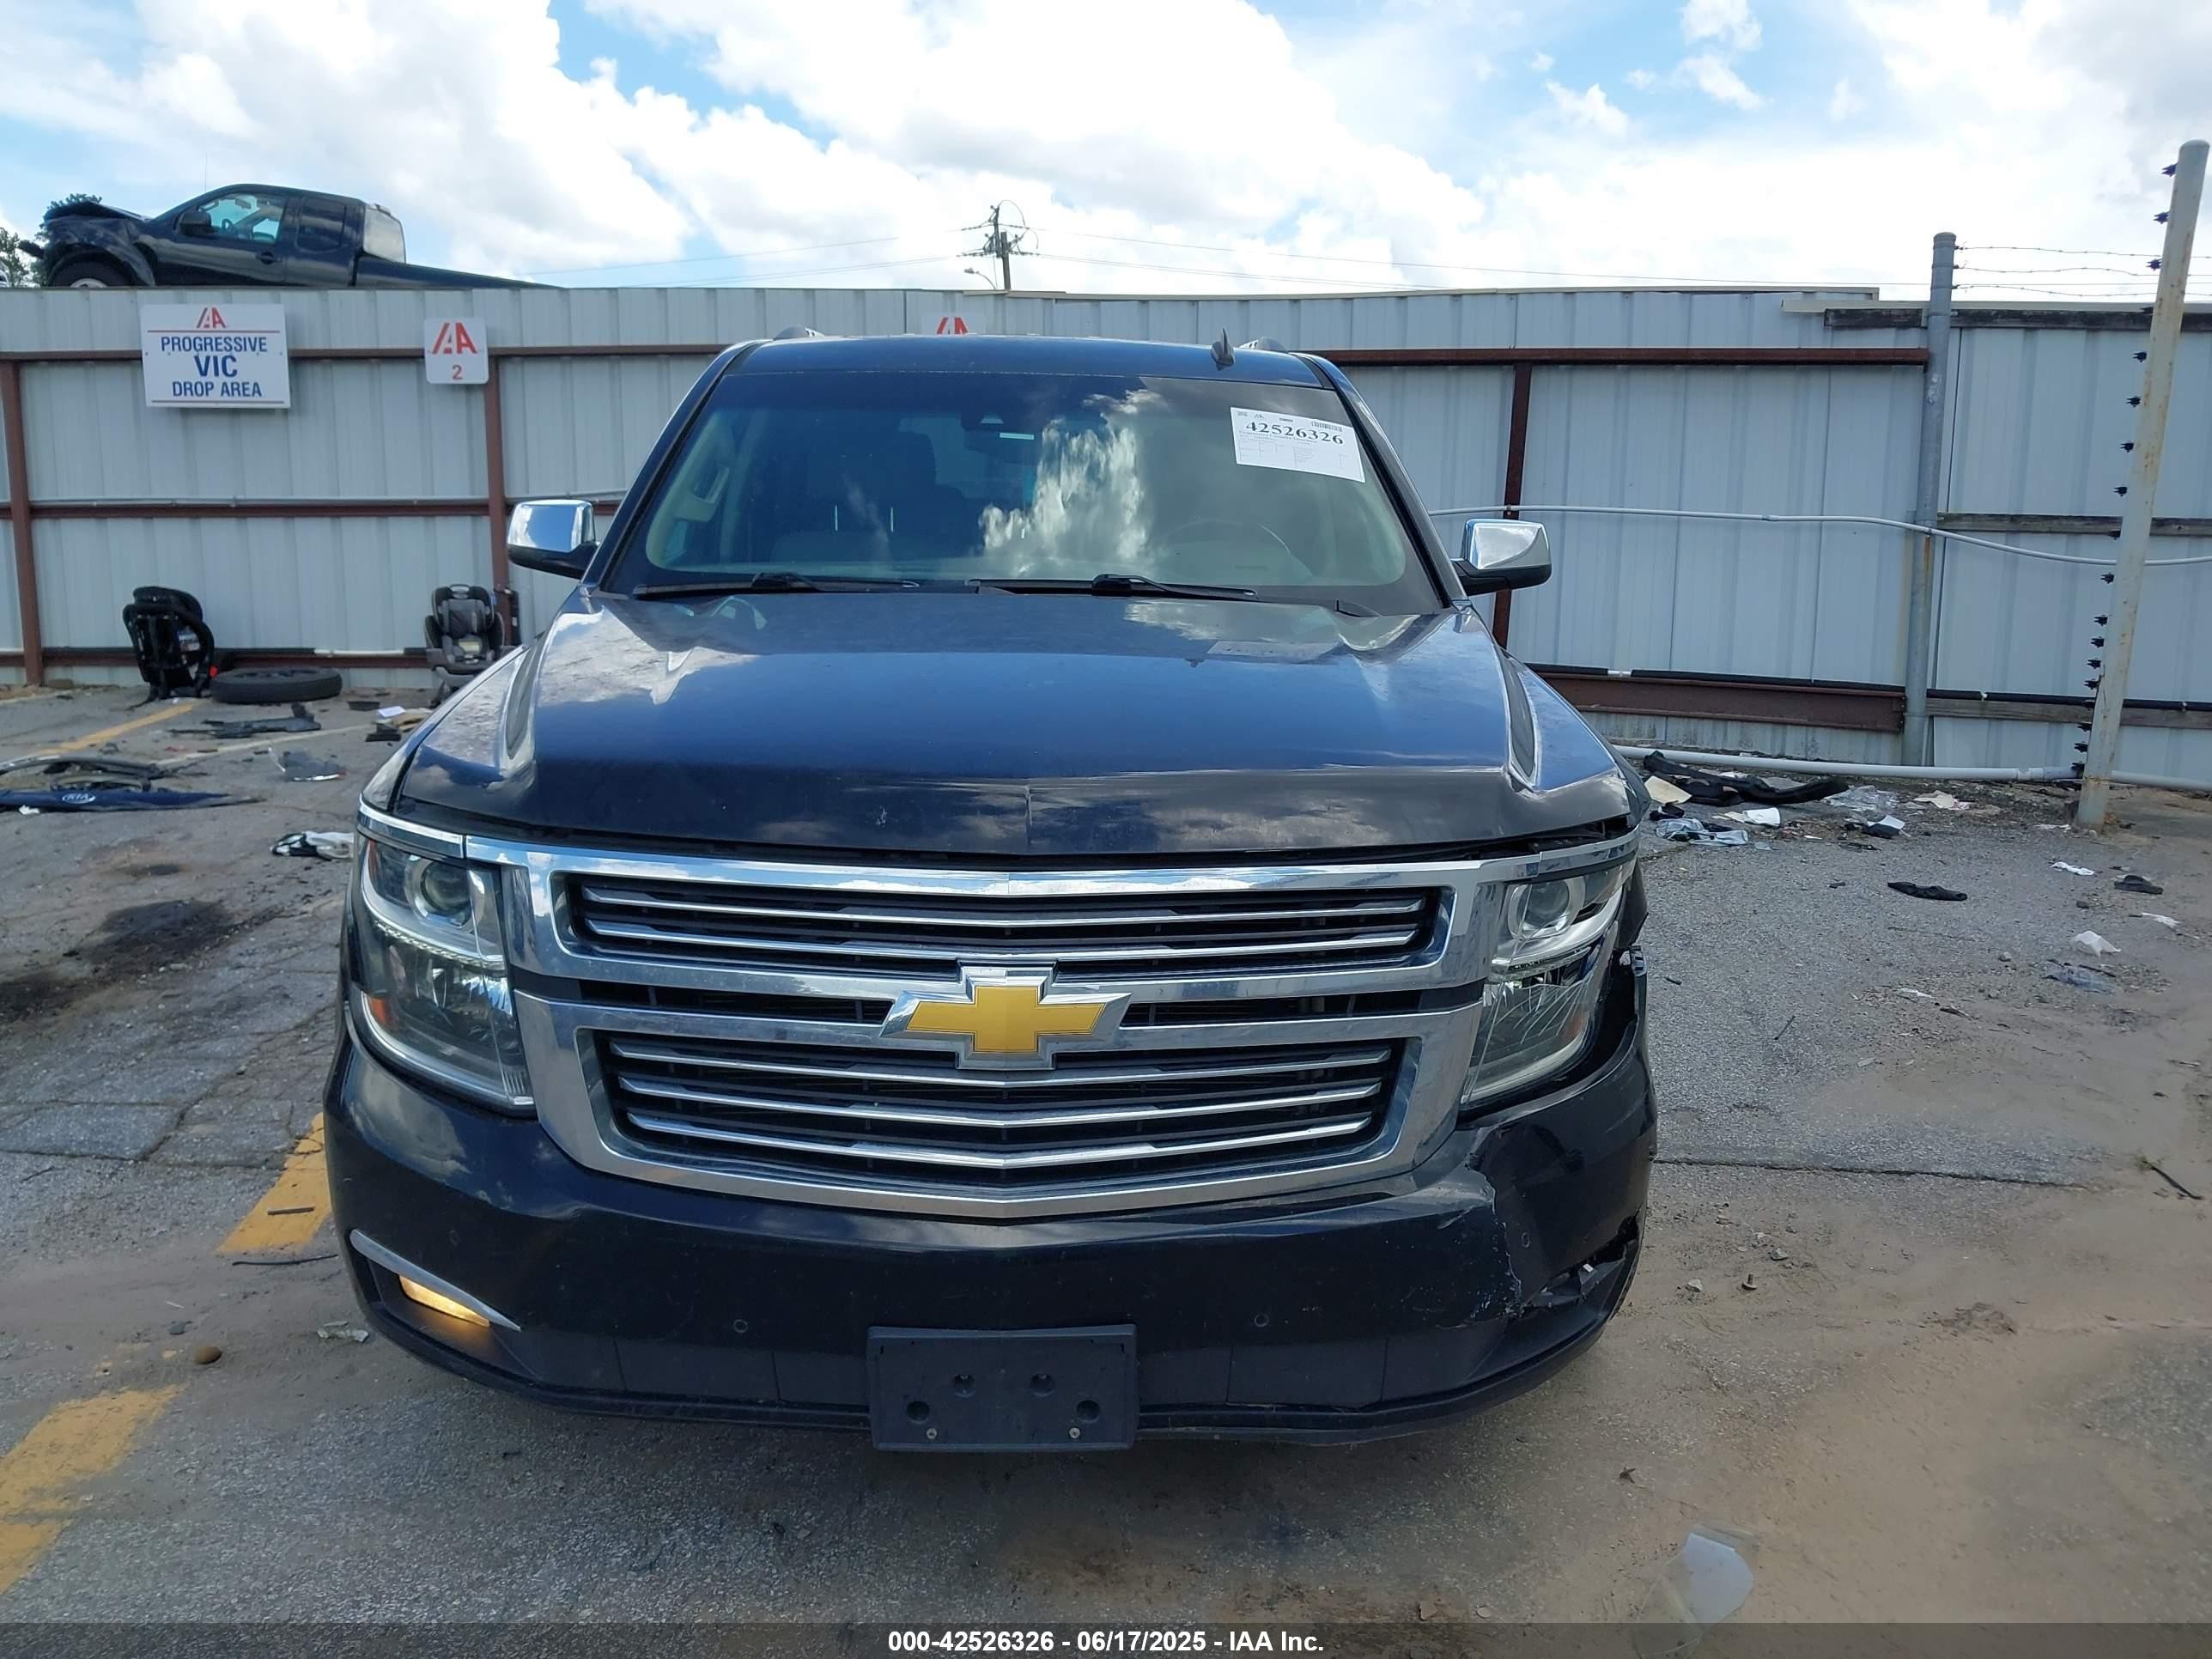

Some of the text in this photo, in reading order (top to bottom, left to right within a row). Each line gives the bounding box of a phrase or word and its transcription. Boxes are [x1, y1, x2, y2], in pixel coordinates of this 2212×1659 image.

[161, 336, 268, 353] PROGRESSIVE
[193, 355, 238, 378] VIC
[452, 364, 463, 380] 2
[173, 380, 263, 398] DROP AREA
[1245, 421, 1344, 445] 42526326
